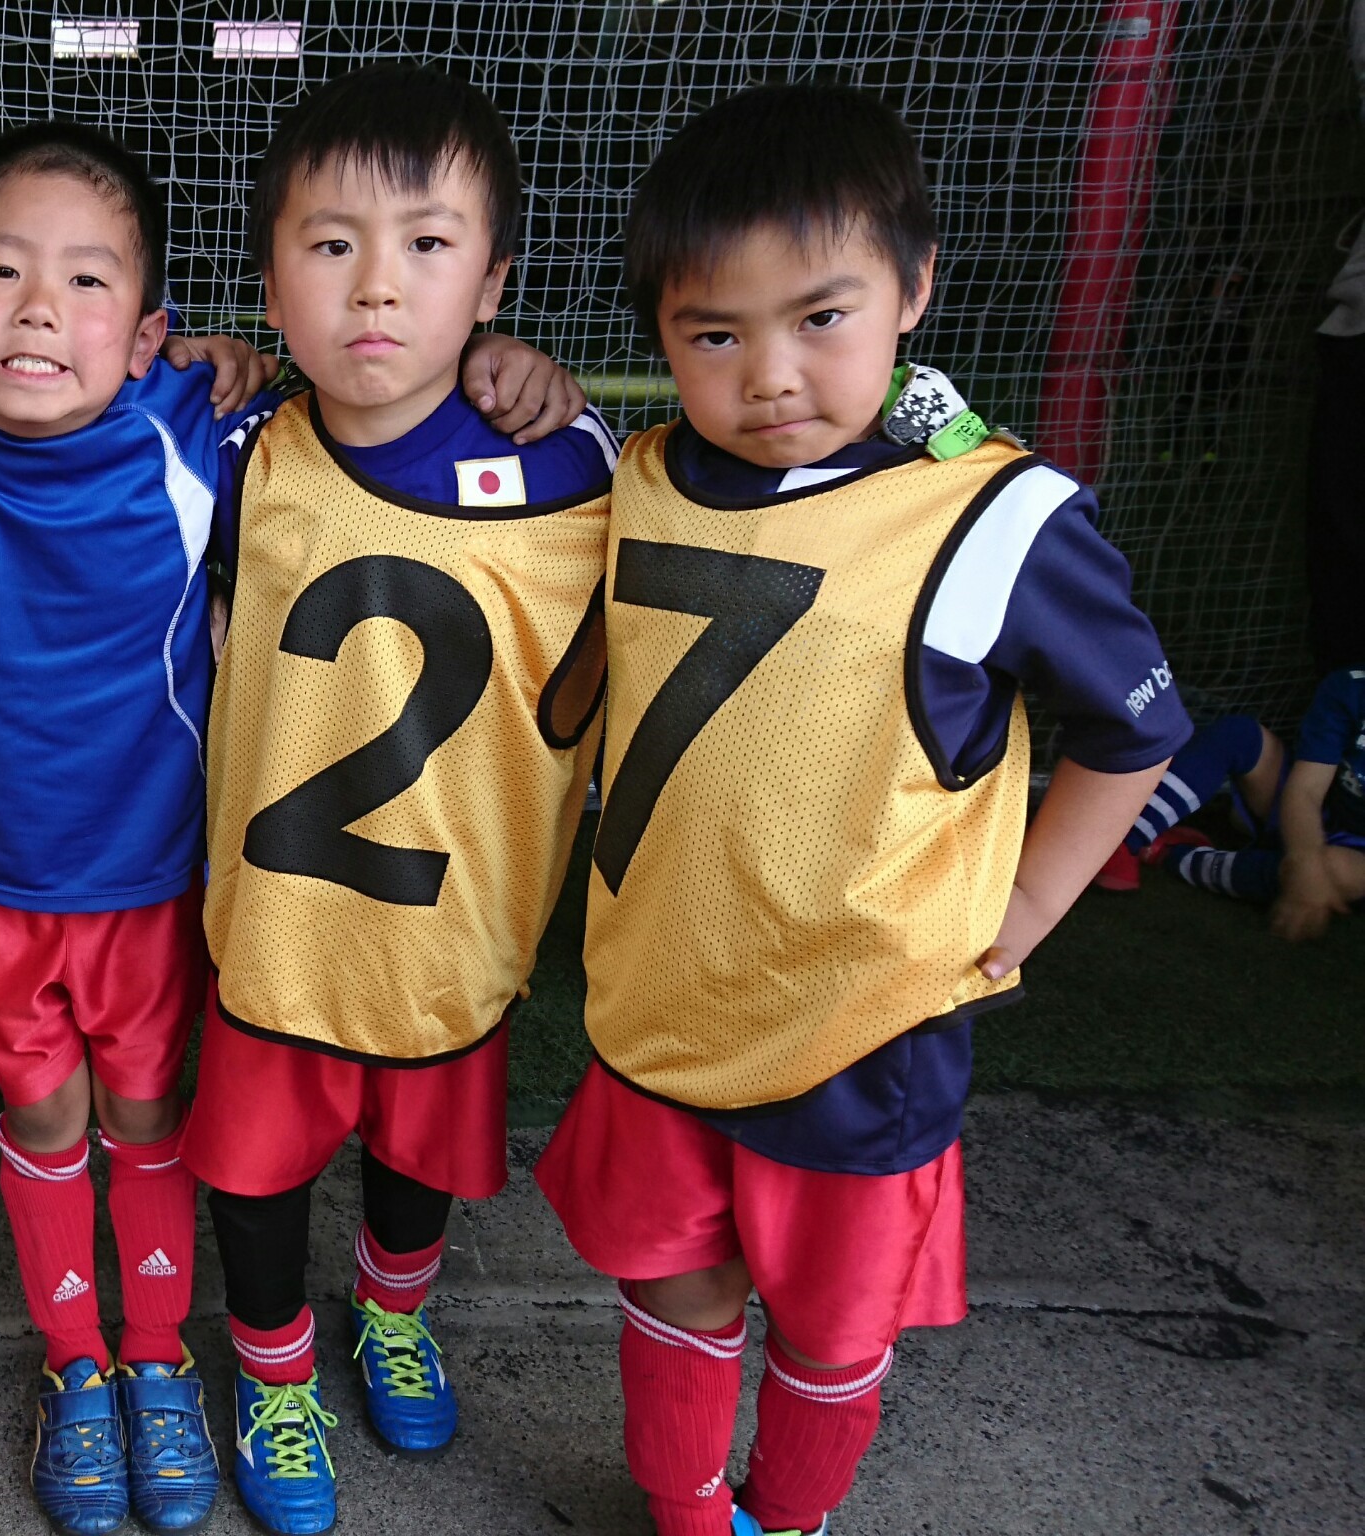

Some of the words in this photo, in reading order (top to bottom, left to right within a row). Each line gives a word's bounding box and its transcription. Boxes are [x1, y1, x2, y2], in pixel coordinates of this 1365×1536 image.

[592, 537, 827, 898] 7
[1125, 678, 1155, 718] new
[241, 554, 494, 906] 2
[138, 1264, 177, 1276] adidas
[53, 1280, 89, 1302] adidas
